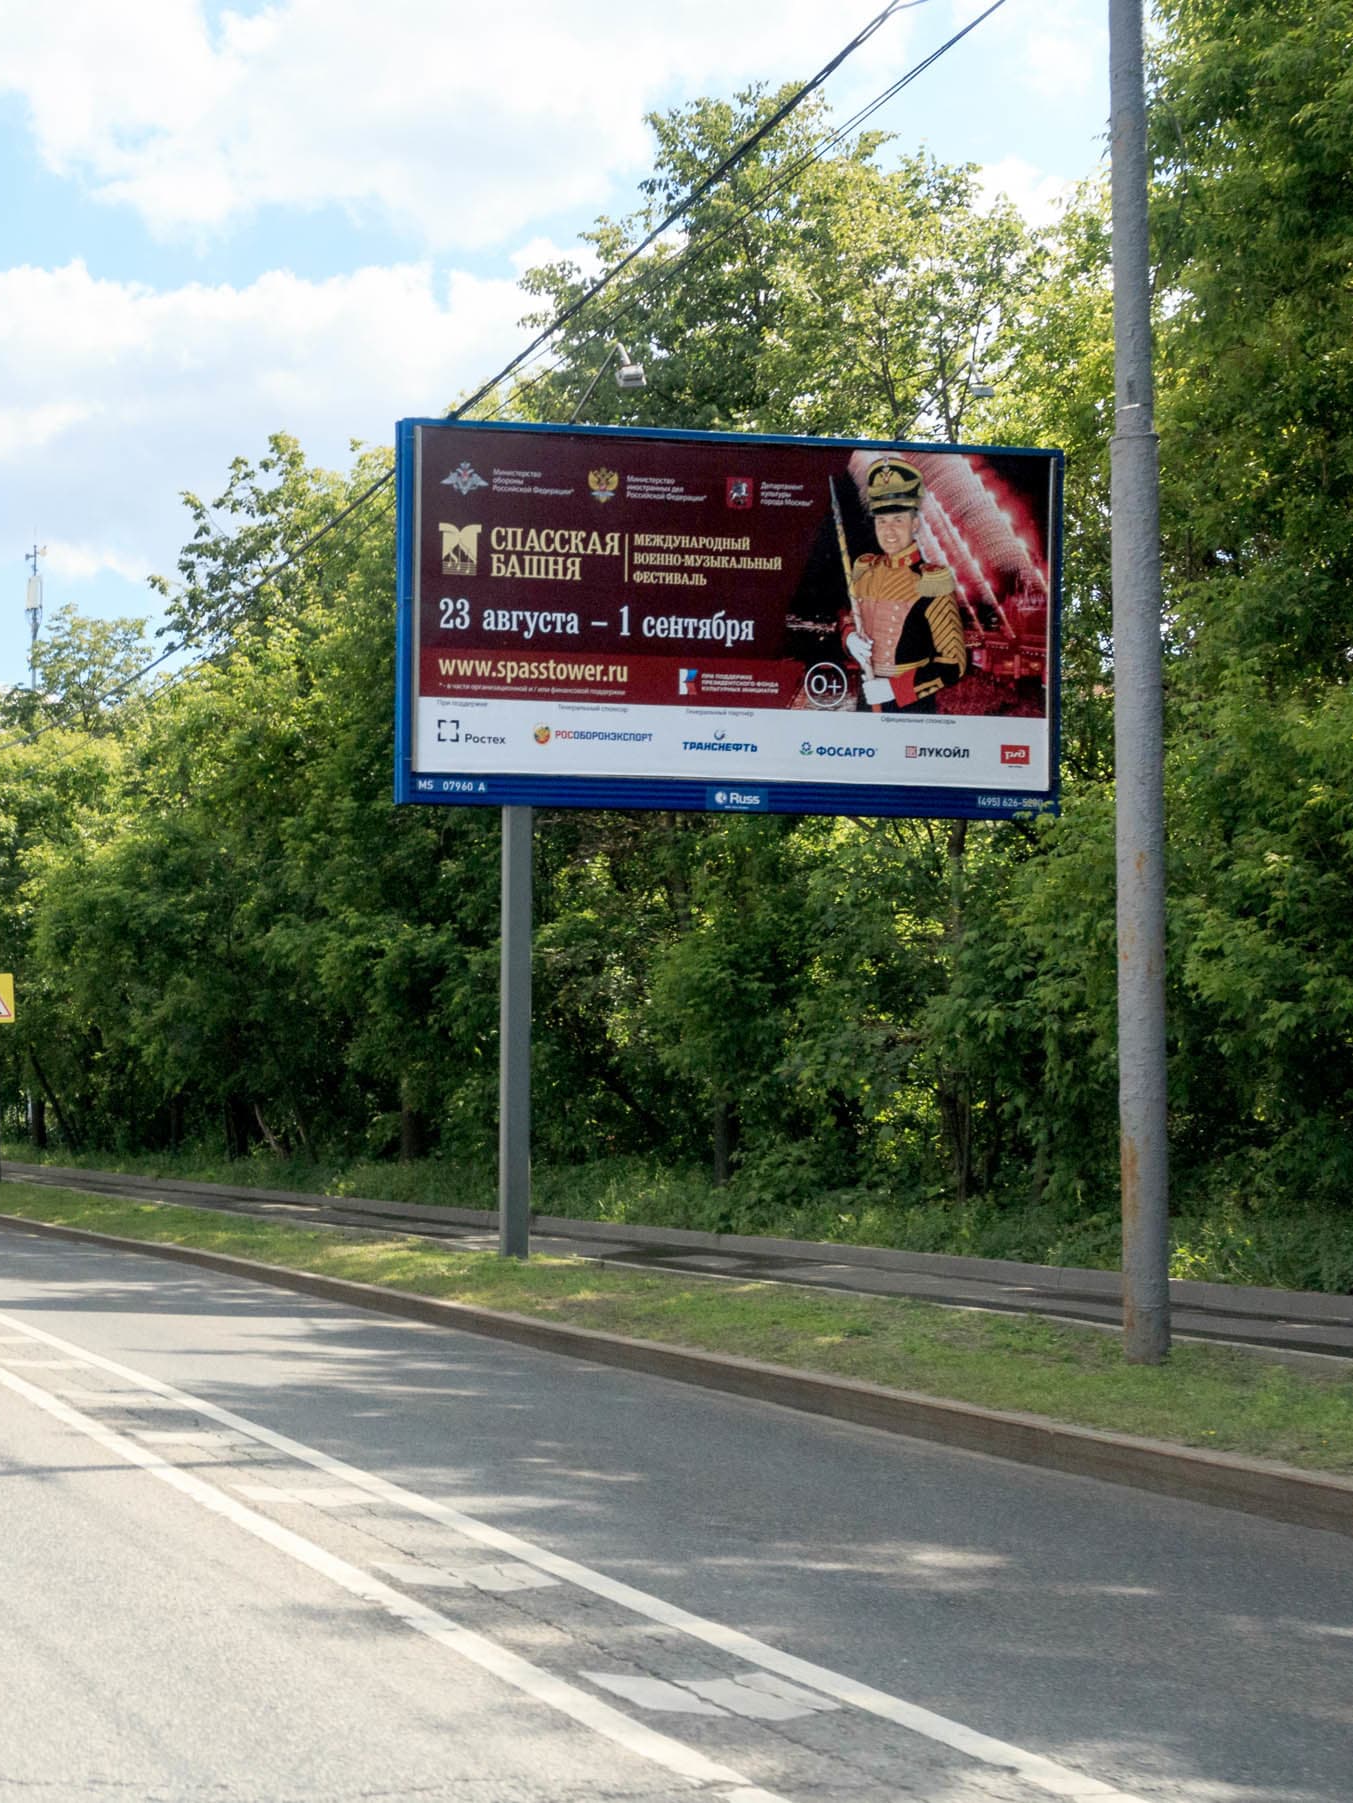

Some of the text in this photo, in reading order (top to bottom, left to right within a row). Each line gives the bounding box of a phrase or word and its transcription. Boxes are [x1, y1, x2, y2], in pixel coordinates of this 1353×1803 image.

[490, 526, 621, 556] СПАССКАЯ
[633, 533, 751, 551] МЕЖДУНАРОДНЫЙ
[490, 553, 582, 580] БАШНЯ
[633, 552, 783, 571] ВОЕННО-МУЗЫКАЛЬНЫЙ
[633, 570, 708, 586] ФЕСТИВАЛЬ
[439, 598, 471, 630] 23
[482, 608, 580, 640] августа
[619, 605, 631, 636] 1
[642, 610, 755, 647] сентября
[438, 658, 629, 684] www.spasstower.ru
[810, 674, 842, 696] 0+
[464, 733, 506, 745] Ростех
[554, 730, 653, 742] РОСОБОРОНЭКСПОРТ
[682, 741, 758, 753] ТРАНСНЕФТЬ
[815, 746, 876, 758] ФОСАГРО
[917, 746, 970, 759] ЛУКОЙЛ
[442, 781, 473, 792] 07960
[729, 792, 761, 805] Russ
